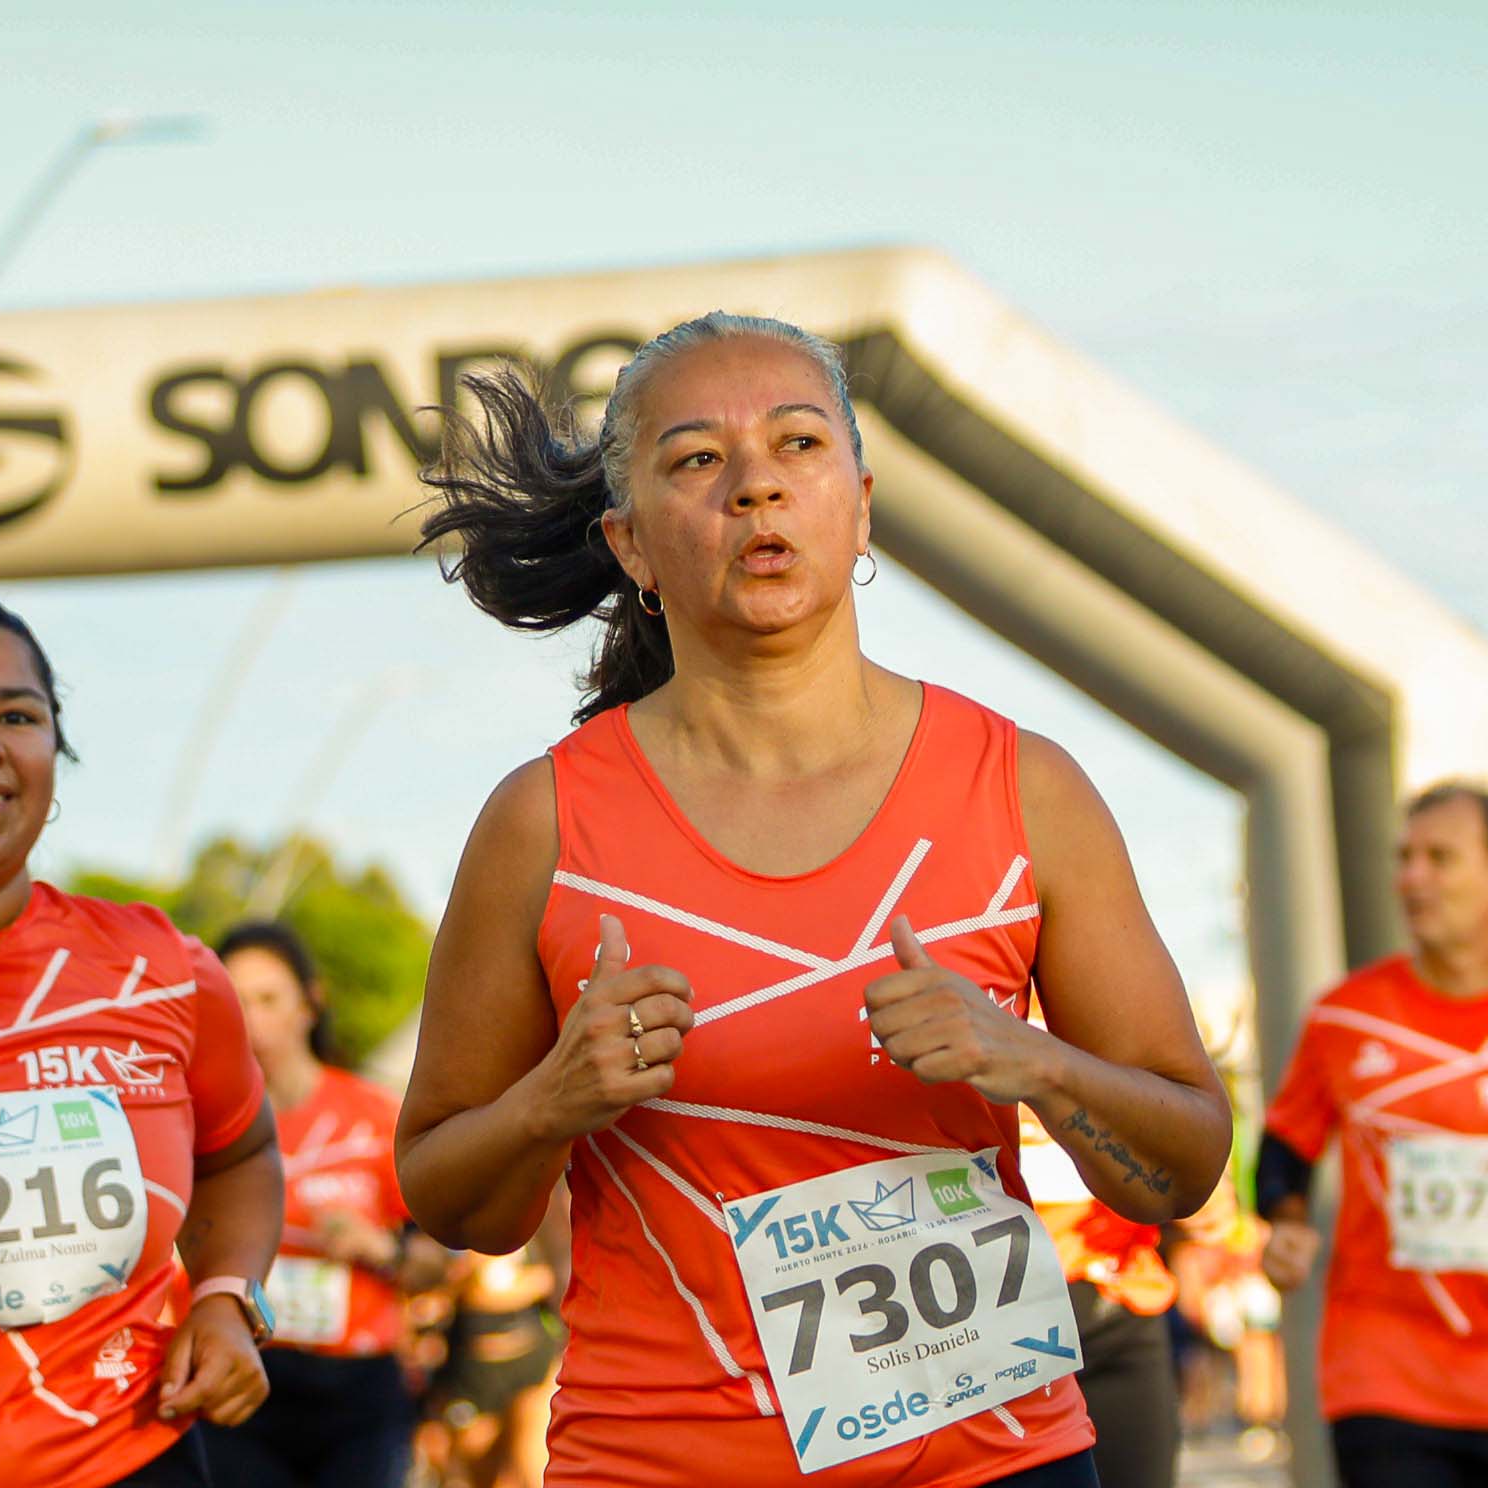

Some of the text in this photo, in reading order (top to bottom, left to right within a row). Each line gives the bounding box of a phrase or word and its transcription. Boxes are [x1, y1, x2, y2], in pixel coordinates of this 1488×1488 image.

[17, 1045, 106, 1085] 15K
[60, 1111, 94, 1130] 10K
[933, 1184, 971, 1204] 10K
[764, 1204, 851, 1259] 15K
[775, 1258, 810, 1274] PUERTO
[813, 1250, 843, 1263] NORTE
[878, 1228, 917, 1246] ROSARIO
[760, 1214, 1031, 1377] 7307
[867, 1327, 980, 1375] Solis Daniela
[836, 1389, 930, 1440] osde
